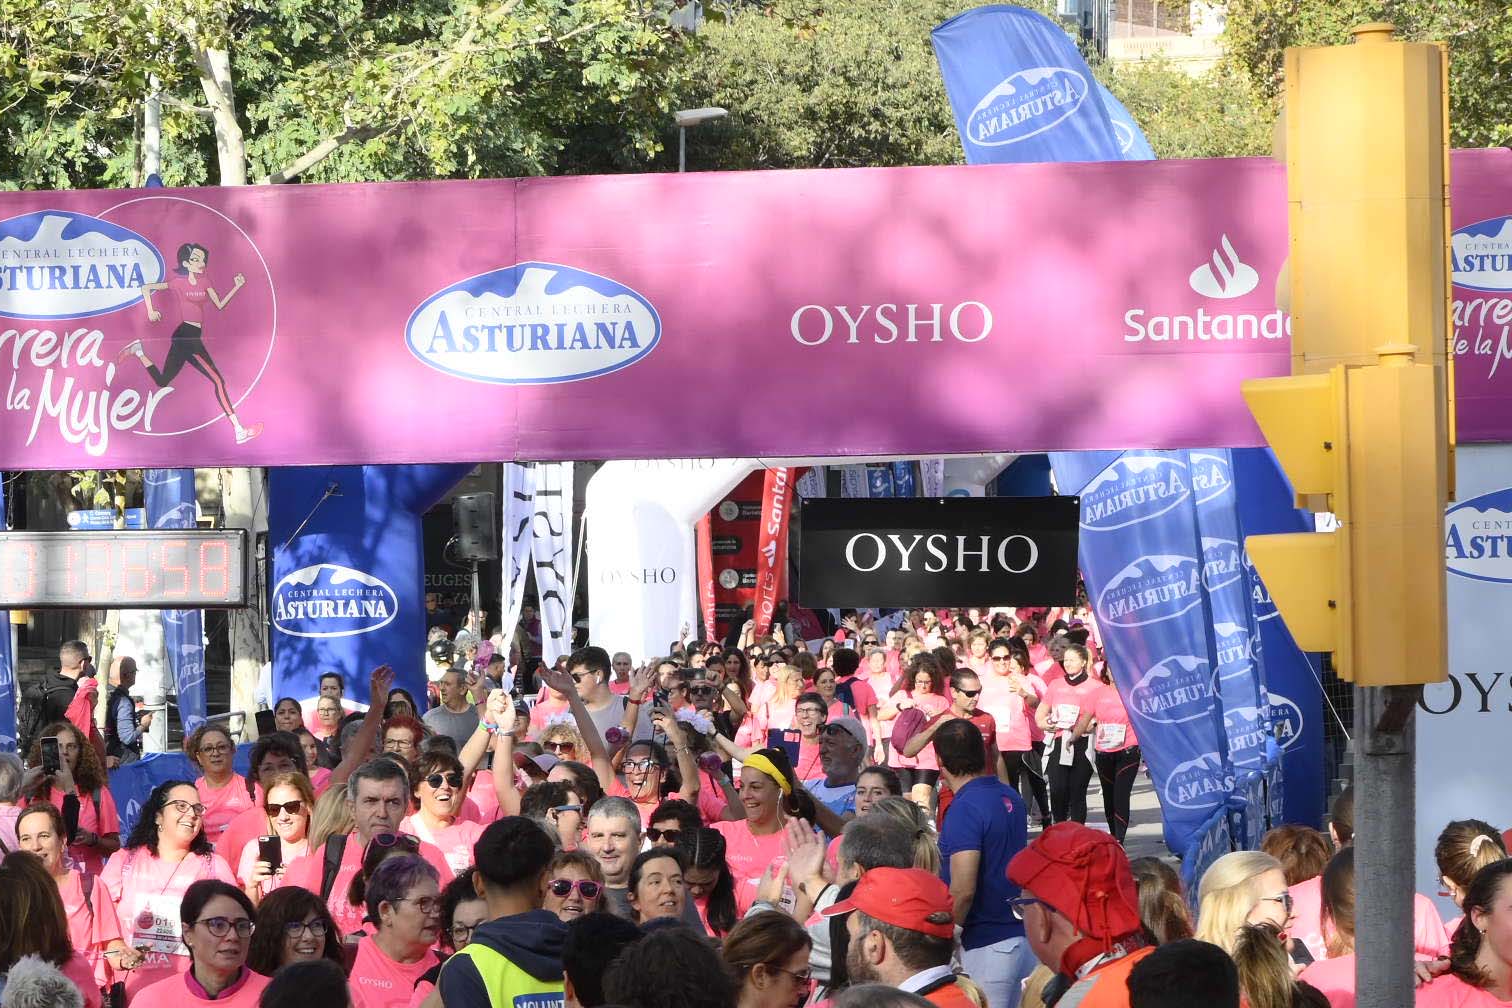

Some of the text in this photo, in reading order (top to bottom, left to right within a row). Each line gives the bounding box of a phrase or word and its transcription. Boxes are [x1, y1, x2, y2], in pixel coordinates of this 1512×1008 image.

[68, 246, 140, 259] LECHERA
[464, 305, 544, 319] CENTRAL
[790, 301, 993, 346] OYSHO
[425, 309, 642, 353] ASTURIANA
[6, 371, 31, 411] la
[25, 363, 176, 457] Mujer
[846, 532, 1039, 573] OYSHO
[288, 587, 384, 598] CENTRAL LECHERA
[275, 595, 389, 622] ASTURIANA
[358, 976, 393, 989] OYSHO
